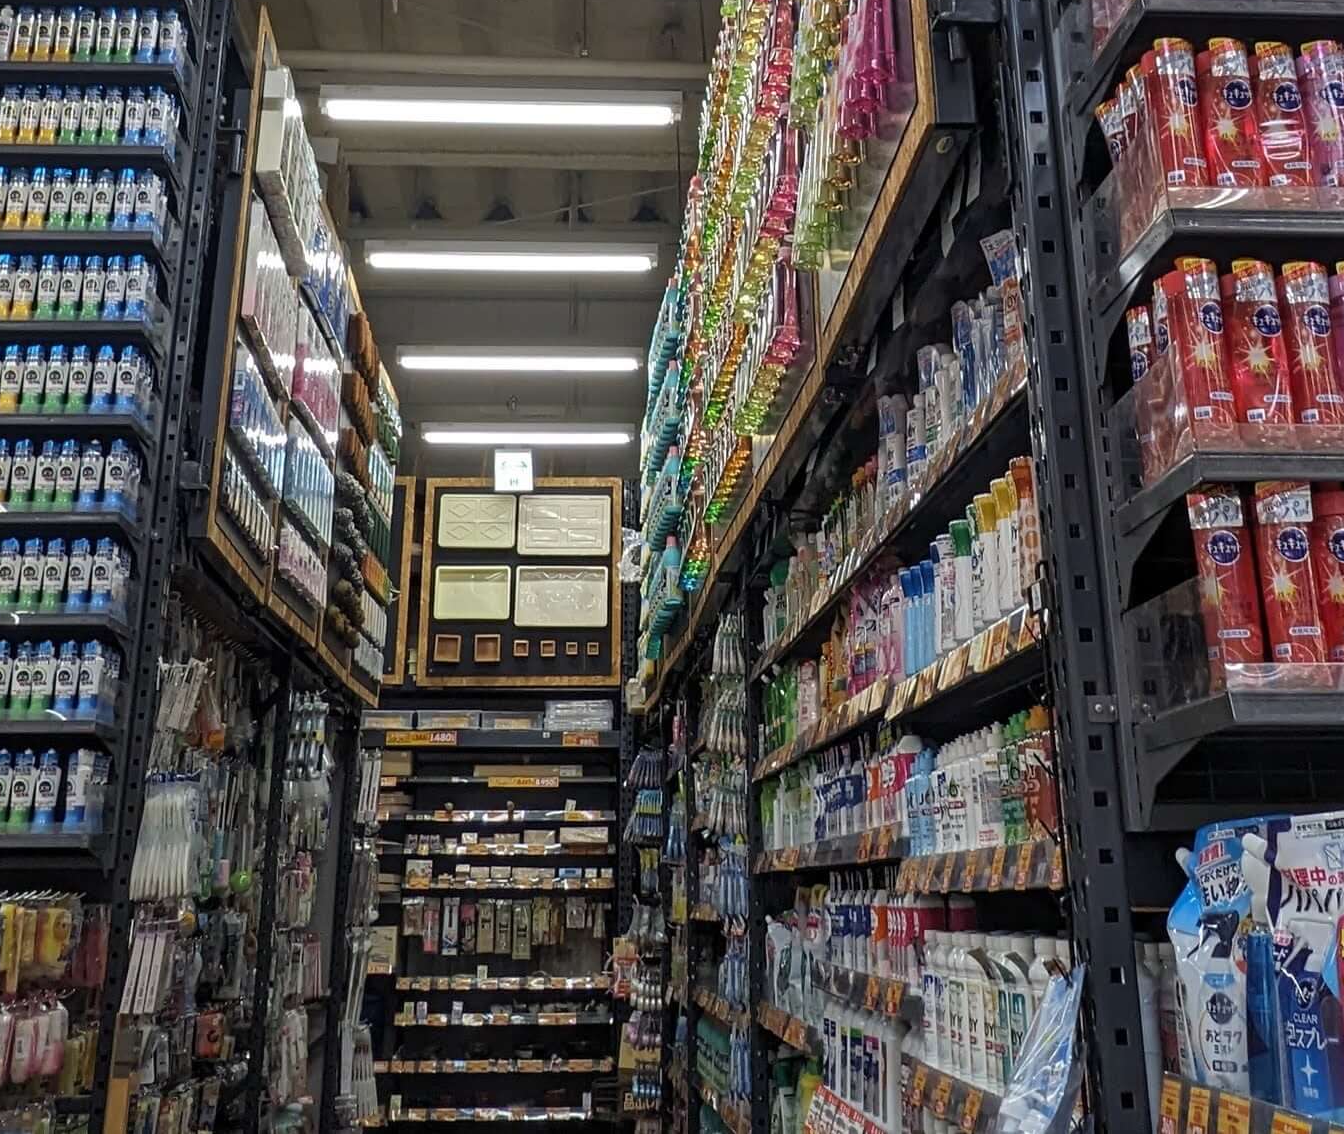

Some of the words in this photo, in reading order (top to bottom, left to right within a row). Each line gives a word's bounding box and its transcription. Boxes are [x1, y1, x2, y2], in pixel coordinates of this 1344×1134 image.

[1293, 1012, 1319, 1025] CLEAR
[1205, 1028, 1242, 1043] あとラク
